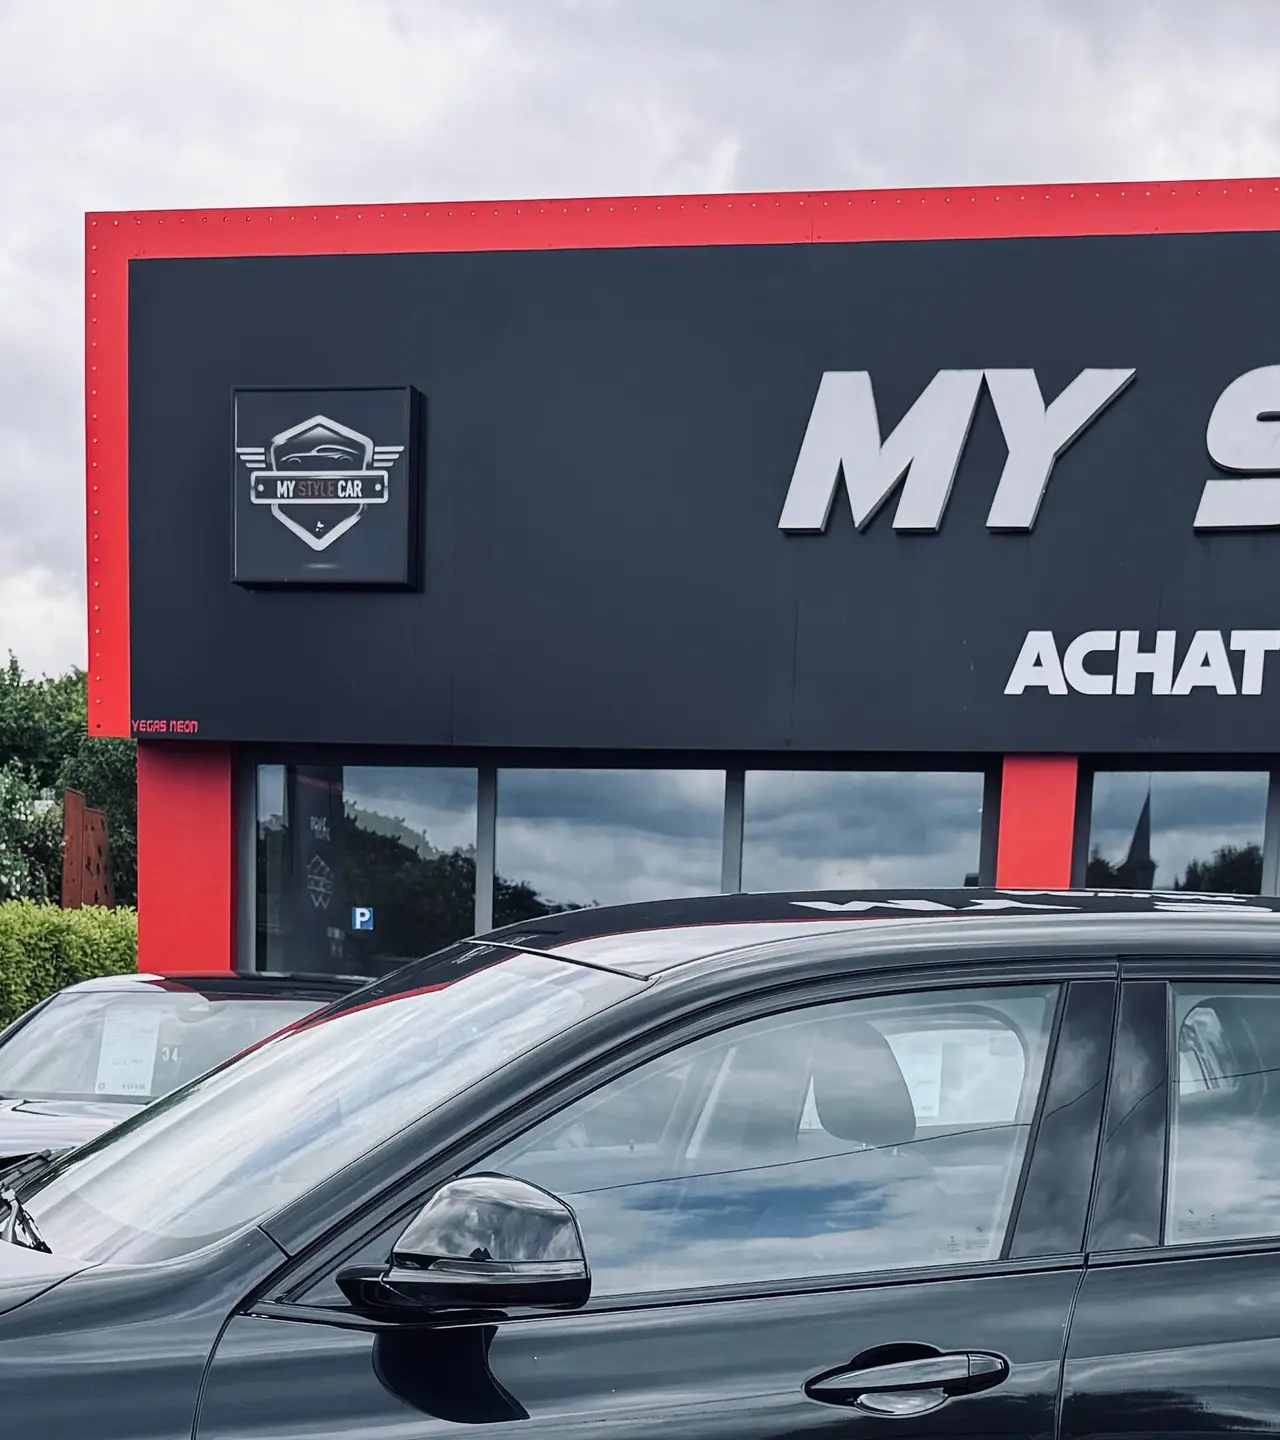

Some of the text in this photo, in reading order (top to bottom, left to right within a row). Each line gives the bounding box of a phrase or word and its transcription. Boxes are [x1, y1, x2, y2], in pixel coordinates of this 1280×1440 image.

[778, 368, 1137, 532] MY
[276, 479, 363, 498] MY STYLE CAR
[131, 719, 167, 732] VEGAS
